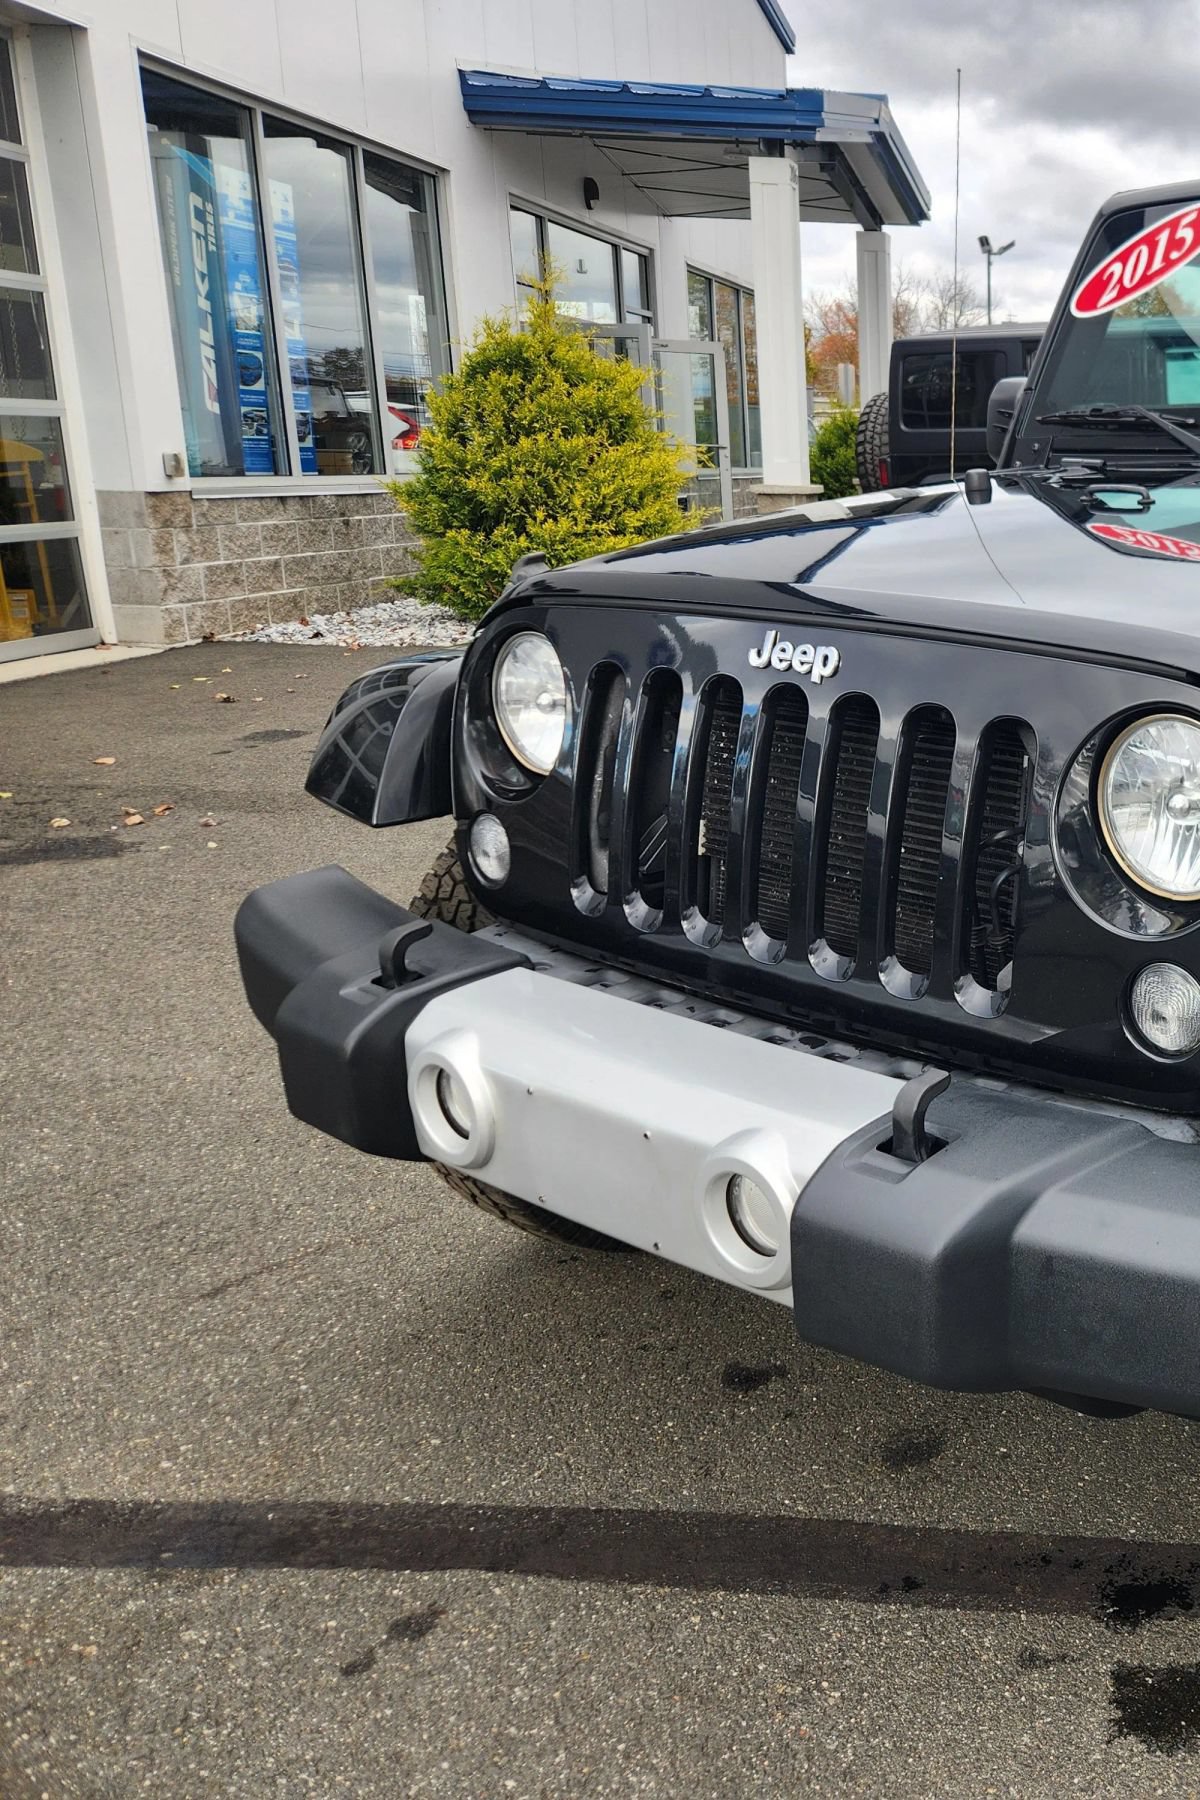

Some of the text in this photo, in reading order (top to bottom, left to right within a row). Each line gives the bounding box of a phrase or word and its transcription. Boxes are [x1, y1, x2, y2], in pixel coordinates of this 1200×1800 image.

[205, 201, 217, 252] TIRES
[1097, 210, 1199, 308] 2015
[189, 192, 220, 414] FALKEN
[747, 630, 841, 685] Jeep
